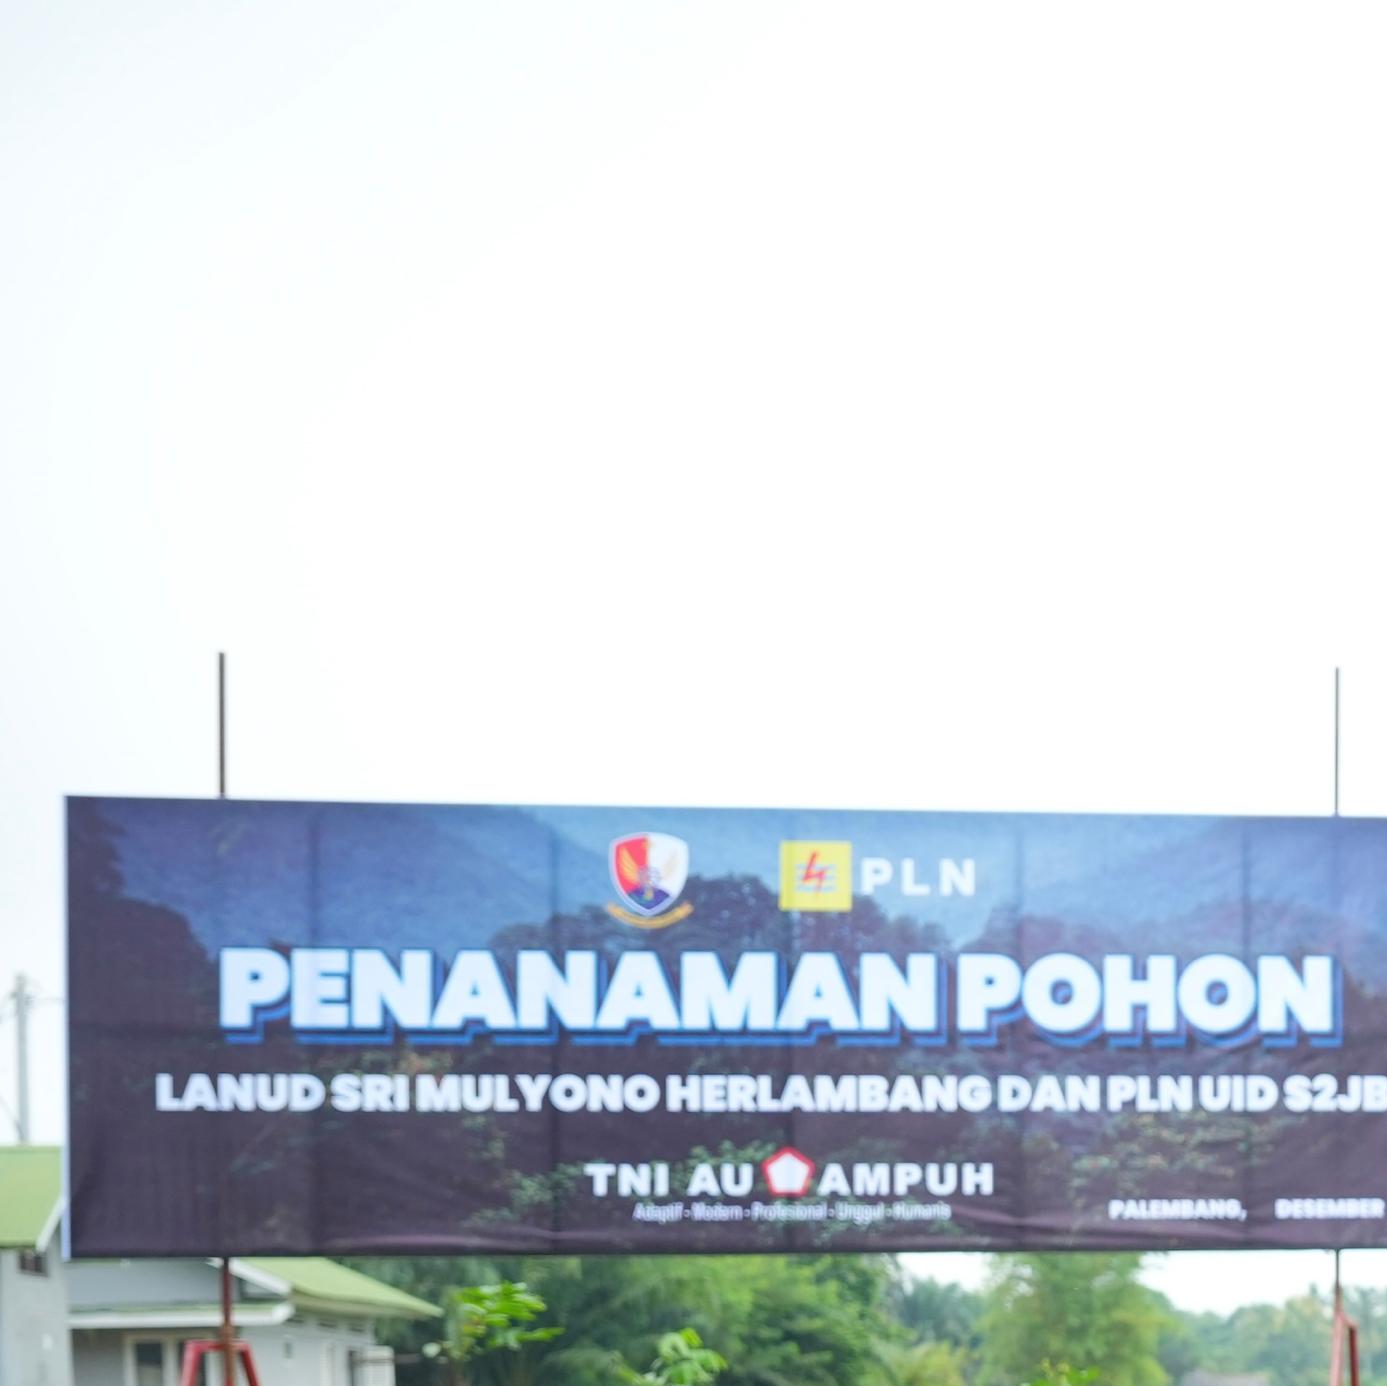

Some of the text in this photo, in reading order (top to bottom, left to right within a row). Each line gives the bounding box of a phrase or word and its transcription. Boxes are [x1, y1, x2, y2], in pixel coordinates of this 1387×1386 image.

[861, 857, 976, 896] PLN
[220, 947, 1336, 1035] PENANAMAN POHON
[156, 1073, 326, 1111] LANUD
[330, 1073, 410, 1112] SRI
[417, 1074, 660, 1112] MULYONO
[667, 1074, 993, 1112] HERLAMBANG
[999, 1075, 1100, 1112] DAN
[1107, 1075, 1193, 1112] PLN
[1199, 1075, 1278, 1112] UID
[584, 1163, 994, 1197] TNI AU AMPUH
[1274, 1199, 1385, 1219] DESEMBER
